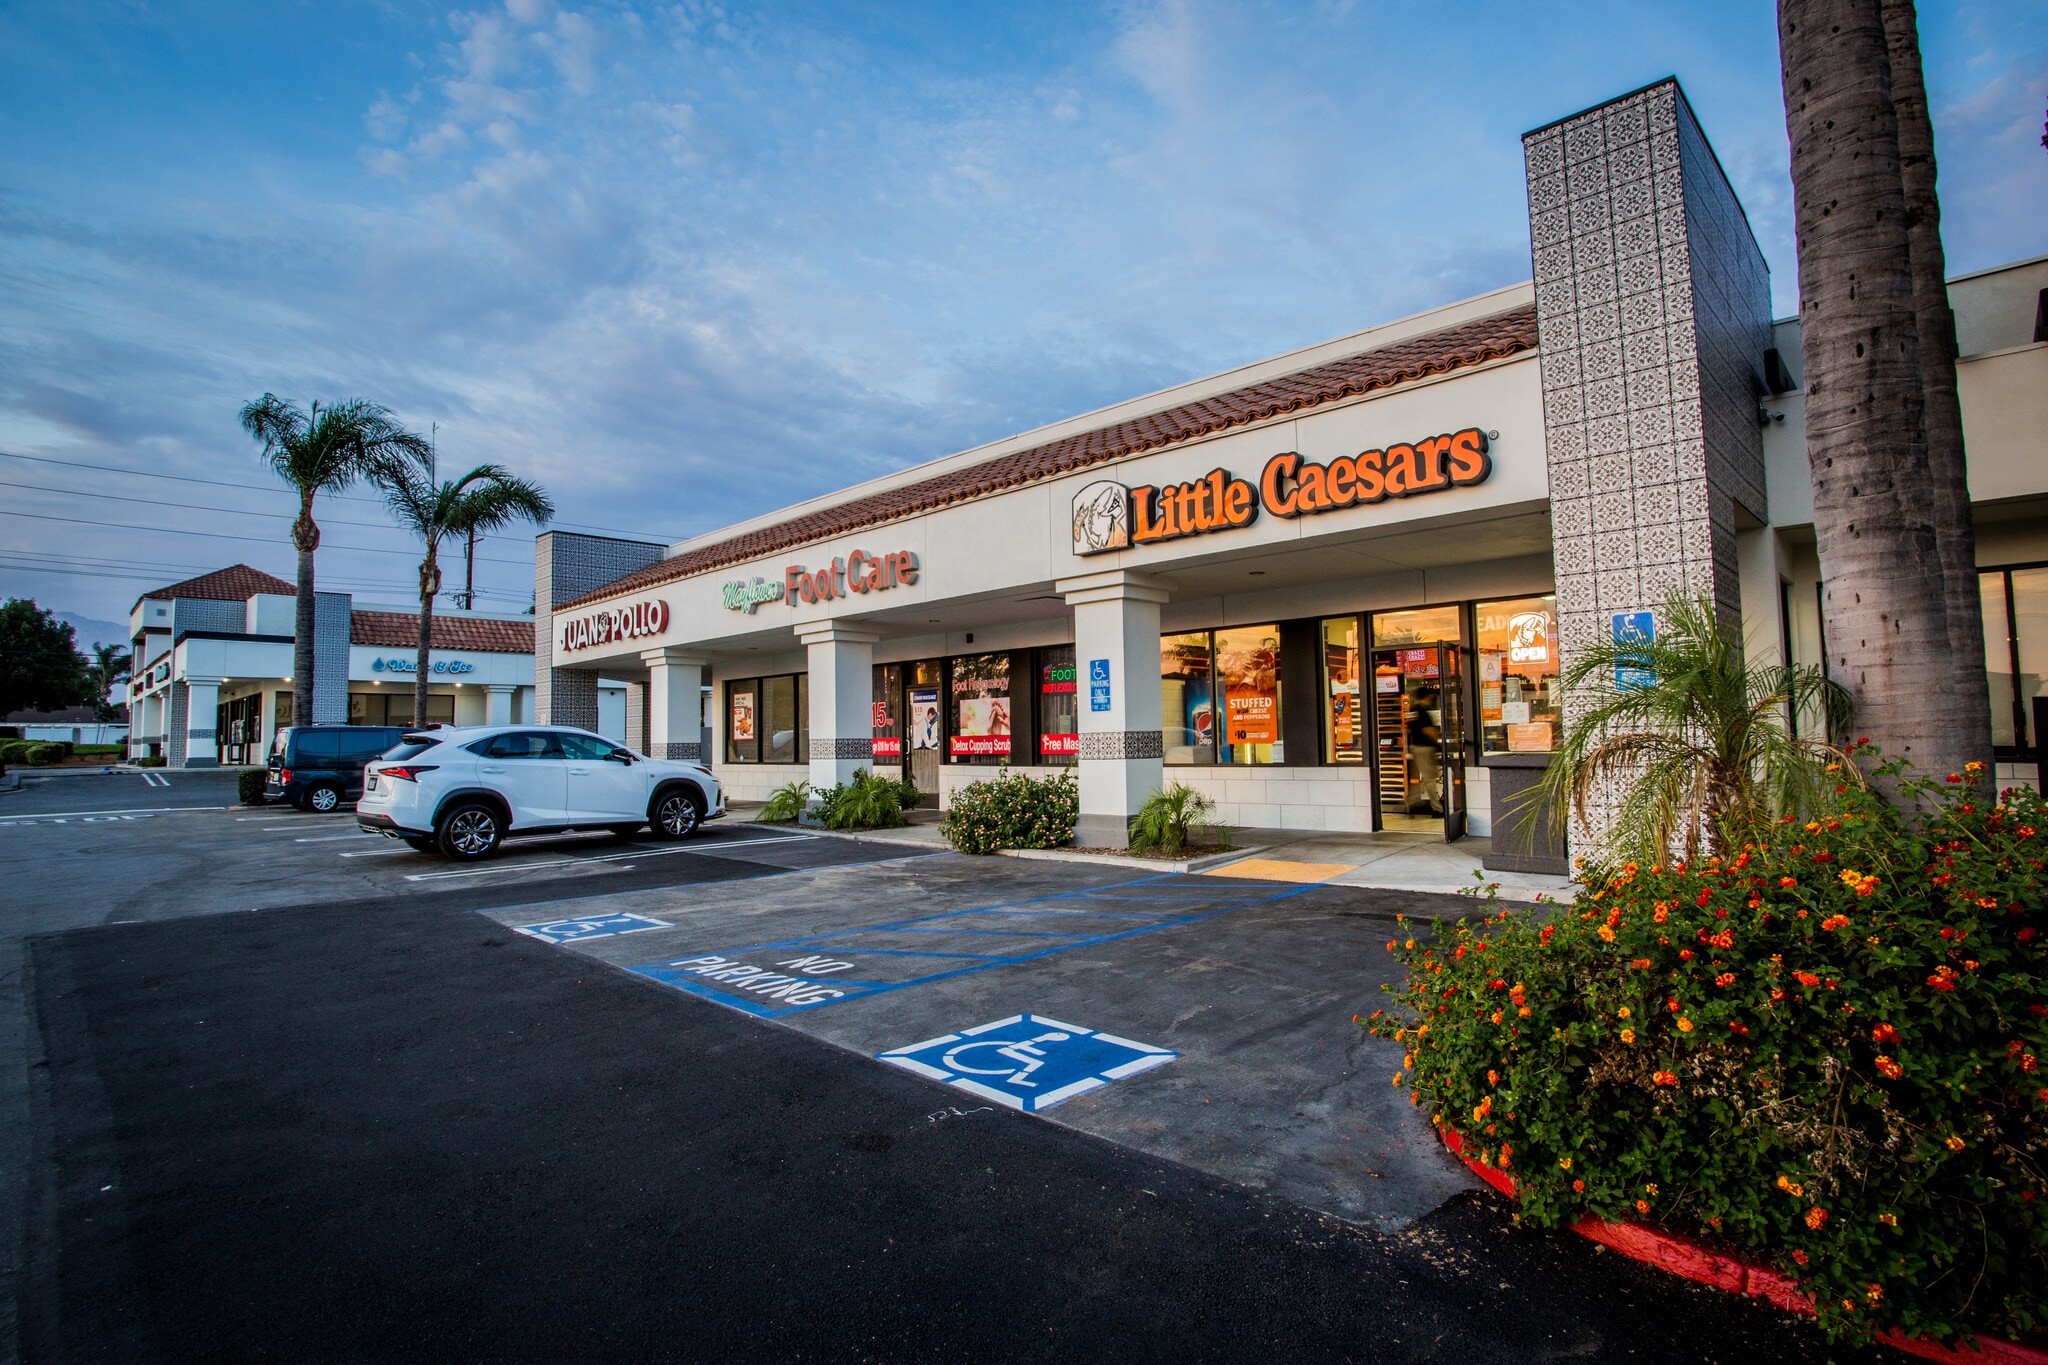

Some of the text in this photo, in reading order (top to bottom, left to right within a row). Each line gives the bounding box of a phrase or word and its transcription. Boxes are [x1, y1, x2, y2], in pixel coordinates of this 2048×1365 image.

[1131, 428, 1492, 544] Little Caesars
[722, 549, 919, 614] Mayflower Foot Care
[560, 599, 667, 651] JUAN POLLO
[1511, 646, 1547, 662] OPEN
[388, 659, 473, 674] Wat & Ice
[1486, 661, 1495, 672] A
[1051, 668, 1077, 681] FOOT
[952, 676, 1009, 692] Foot Reflexology
[1094, 688, 1106, 696] ONLY
[1229, 697, 1272, 709] STUFFED
[952, 739, 969, 752] Detox
[969, 739, 993, 754] Cupping
[1044, 738, 1061, 751] Free
[776, 955, 855, 974] NO
[669, 955, 845, 1005] PARKING
